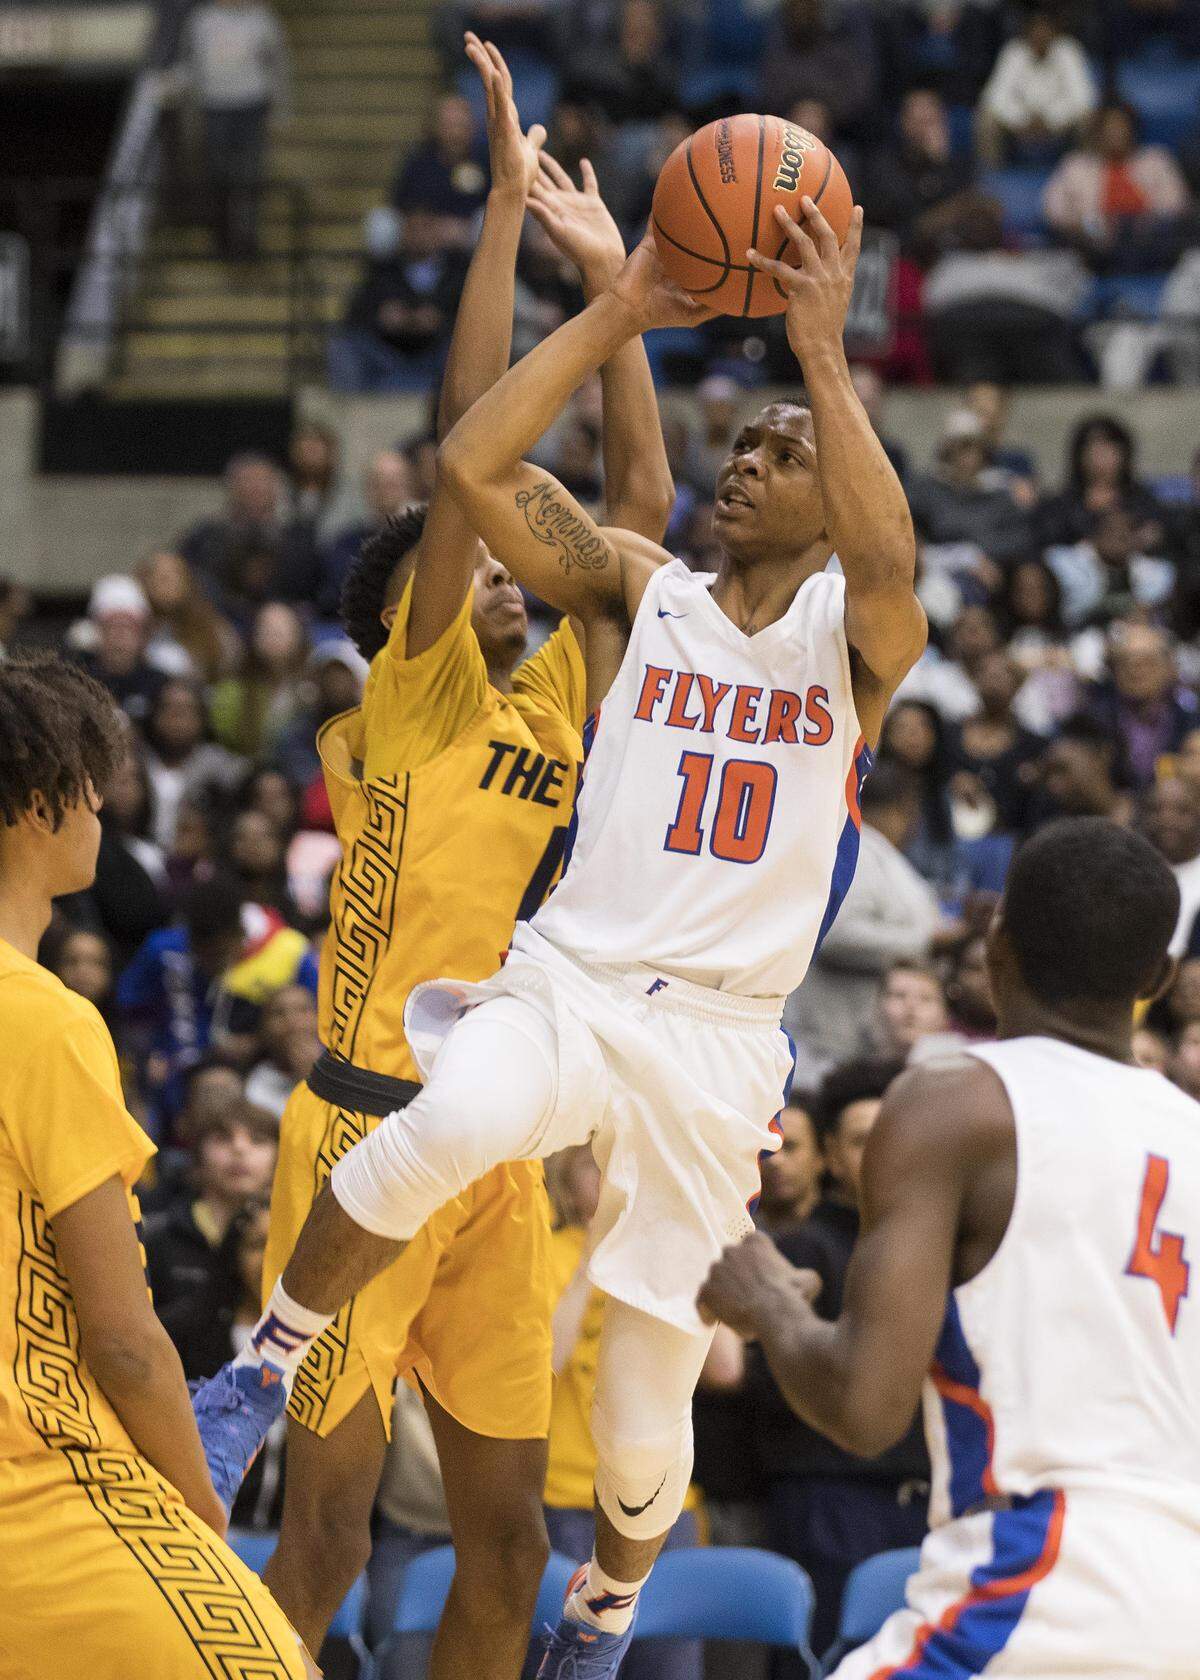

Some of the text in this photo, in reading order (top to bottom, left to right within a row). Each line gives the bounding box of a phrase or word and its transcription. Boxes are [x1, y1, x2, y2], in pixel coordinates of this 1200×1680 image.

[633, 663, 834, 747] FLYERS
[478, 739, 569, 808] THE
[663, 750, 779, 865] 10
[645, 977, 670, 997] F
[1123, 1151, 1190, 1338] 4
[251, 1309, 317, 1356] F
